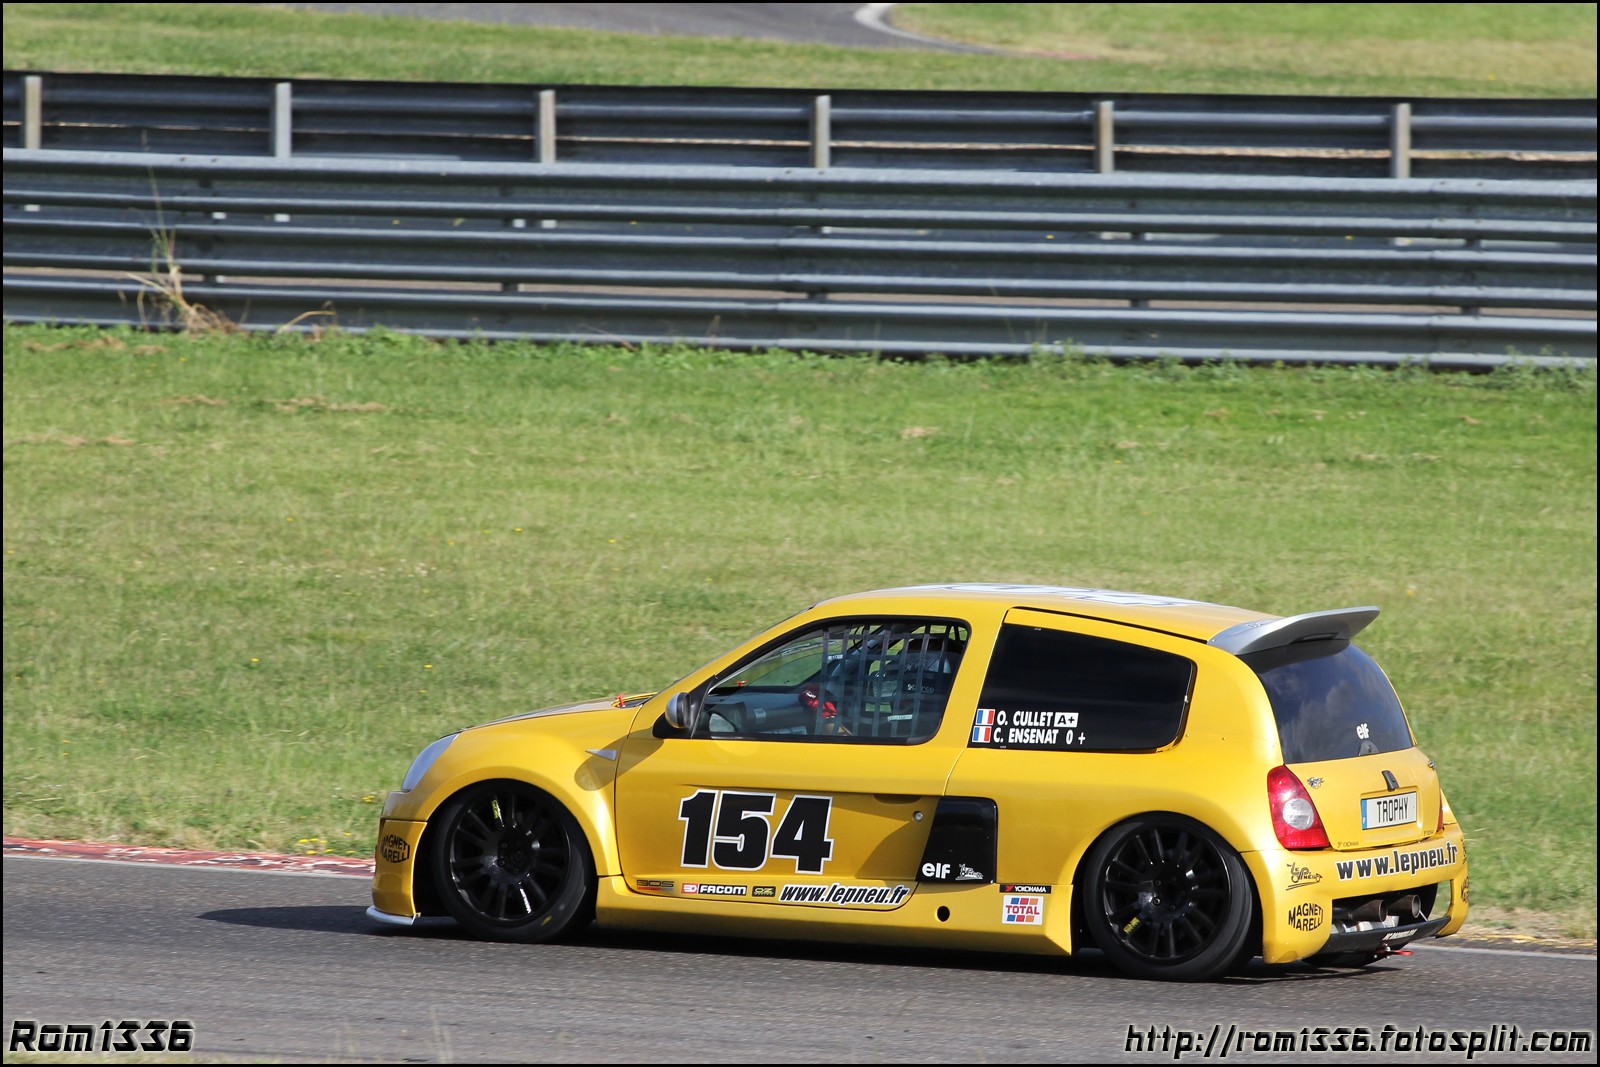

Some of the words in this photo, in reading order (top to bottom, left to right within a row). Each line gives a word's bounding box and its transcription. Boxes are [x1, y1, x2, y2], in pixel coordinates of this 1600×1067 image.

[997, 710, 1008, 725] O.
[1013, 711, 1053, 727] CULLET
[993, 728, 1004, 743] C.
[1008, 728, 1059, 744] ENSENAT
[1356, 723, 1370, 740] elf
[1377, 797, 1409, 823] TROPHY
[679, 789, 834, 875] 154
[1335, 842, 1457, 880] www.lepneu.fr
[922, 862, 950, 879] elf
[700, 886, 747, 895] FACOM
[779, 883, 908, 904] www.lepneu.fr
[1014, 885, 1046, 893] YOKOHAMA
[1006, 905, 1039, 915] TOTAL
[1288, 903, 1323, 917] MAGNETI
[1288, 916, 1323, 931] MARELLI
